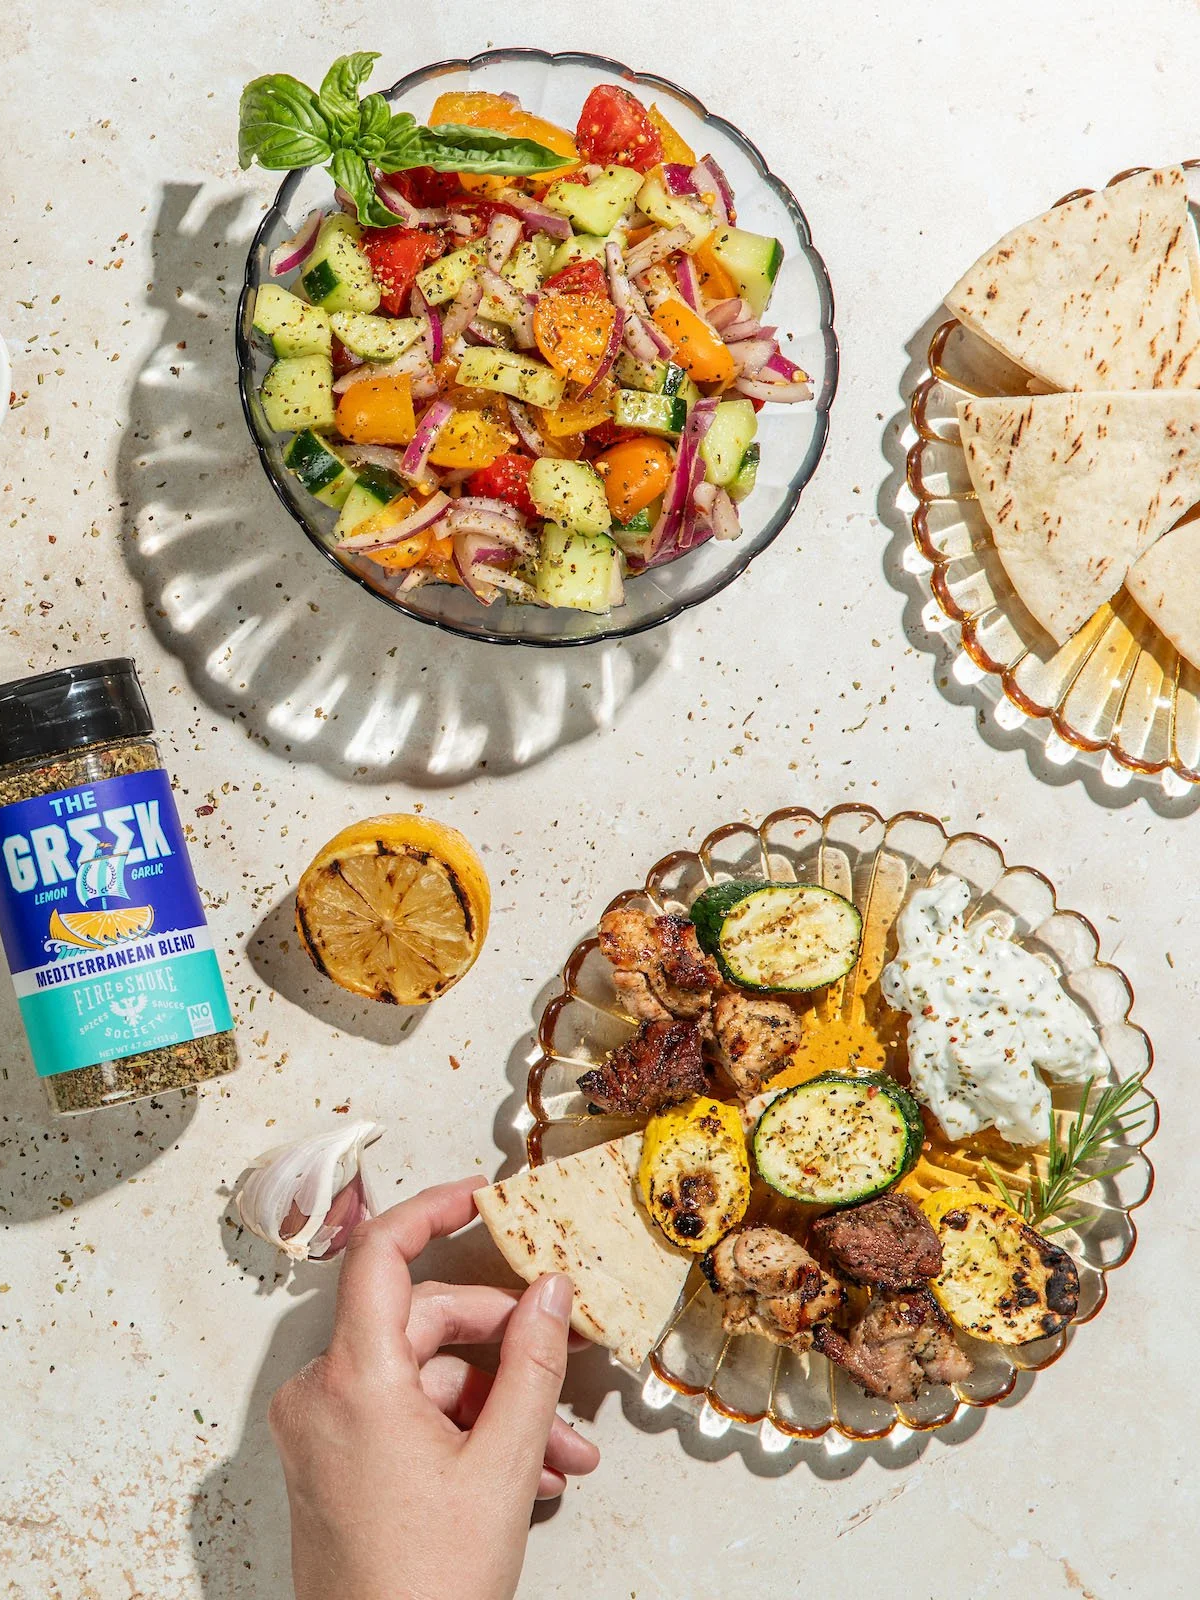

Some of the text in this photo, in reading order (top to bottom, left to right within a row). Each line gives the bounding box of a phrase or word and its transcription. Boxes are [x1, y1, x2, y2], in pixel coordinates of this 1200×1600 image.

[49, 790, 97, 817] THE
[131, 863, 164, 880] GARLIC
[34, 886, 68, 905] LEMON
[35, 934, 196, 988] MEDITERRANEAN BLEND
[73, 981, 114, 1016] FIRE
[125, 966, 177, 993] SMOKE
[152, 1000, 185, 1010] SAUCES
[189, 1004, 210, 1020] NO
[79, 1012, 109, 1035] SPICES
[99, 1048, 115, 1058] NET
[115, 1045, 129, 1054] WT
[131, 1040, 141, 1050] 4.7
